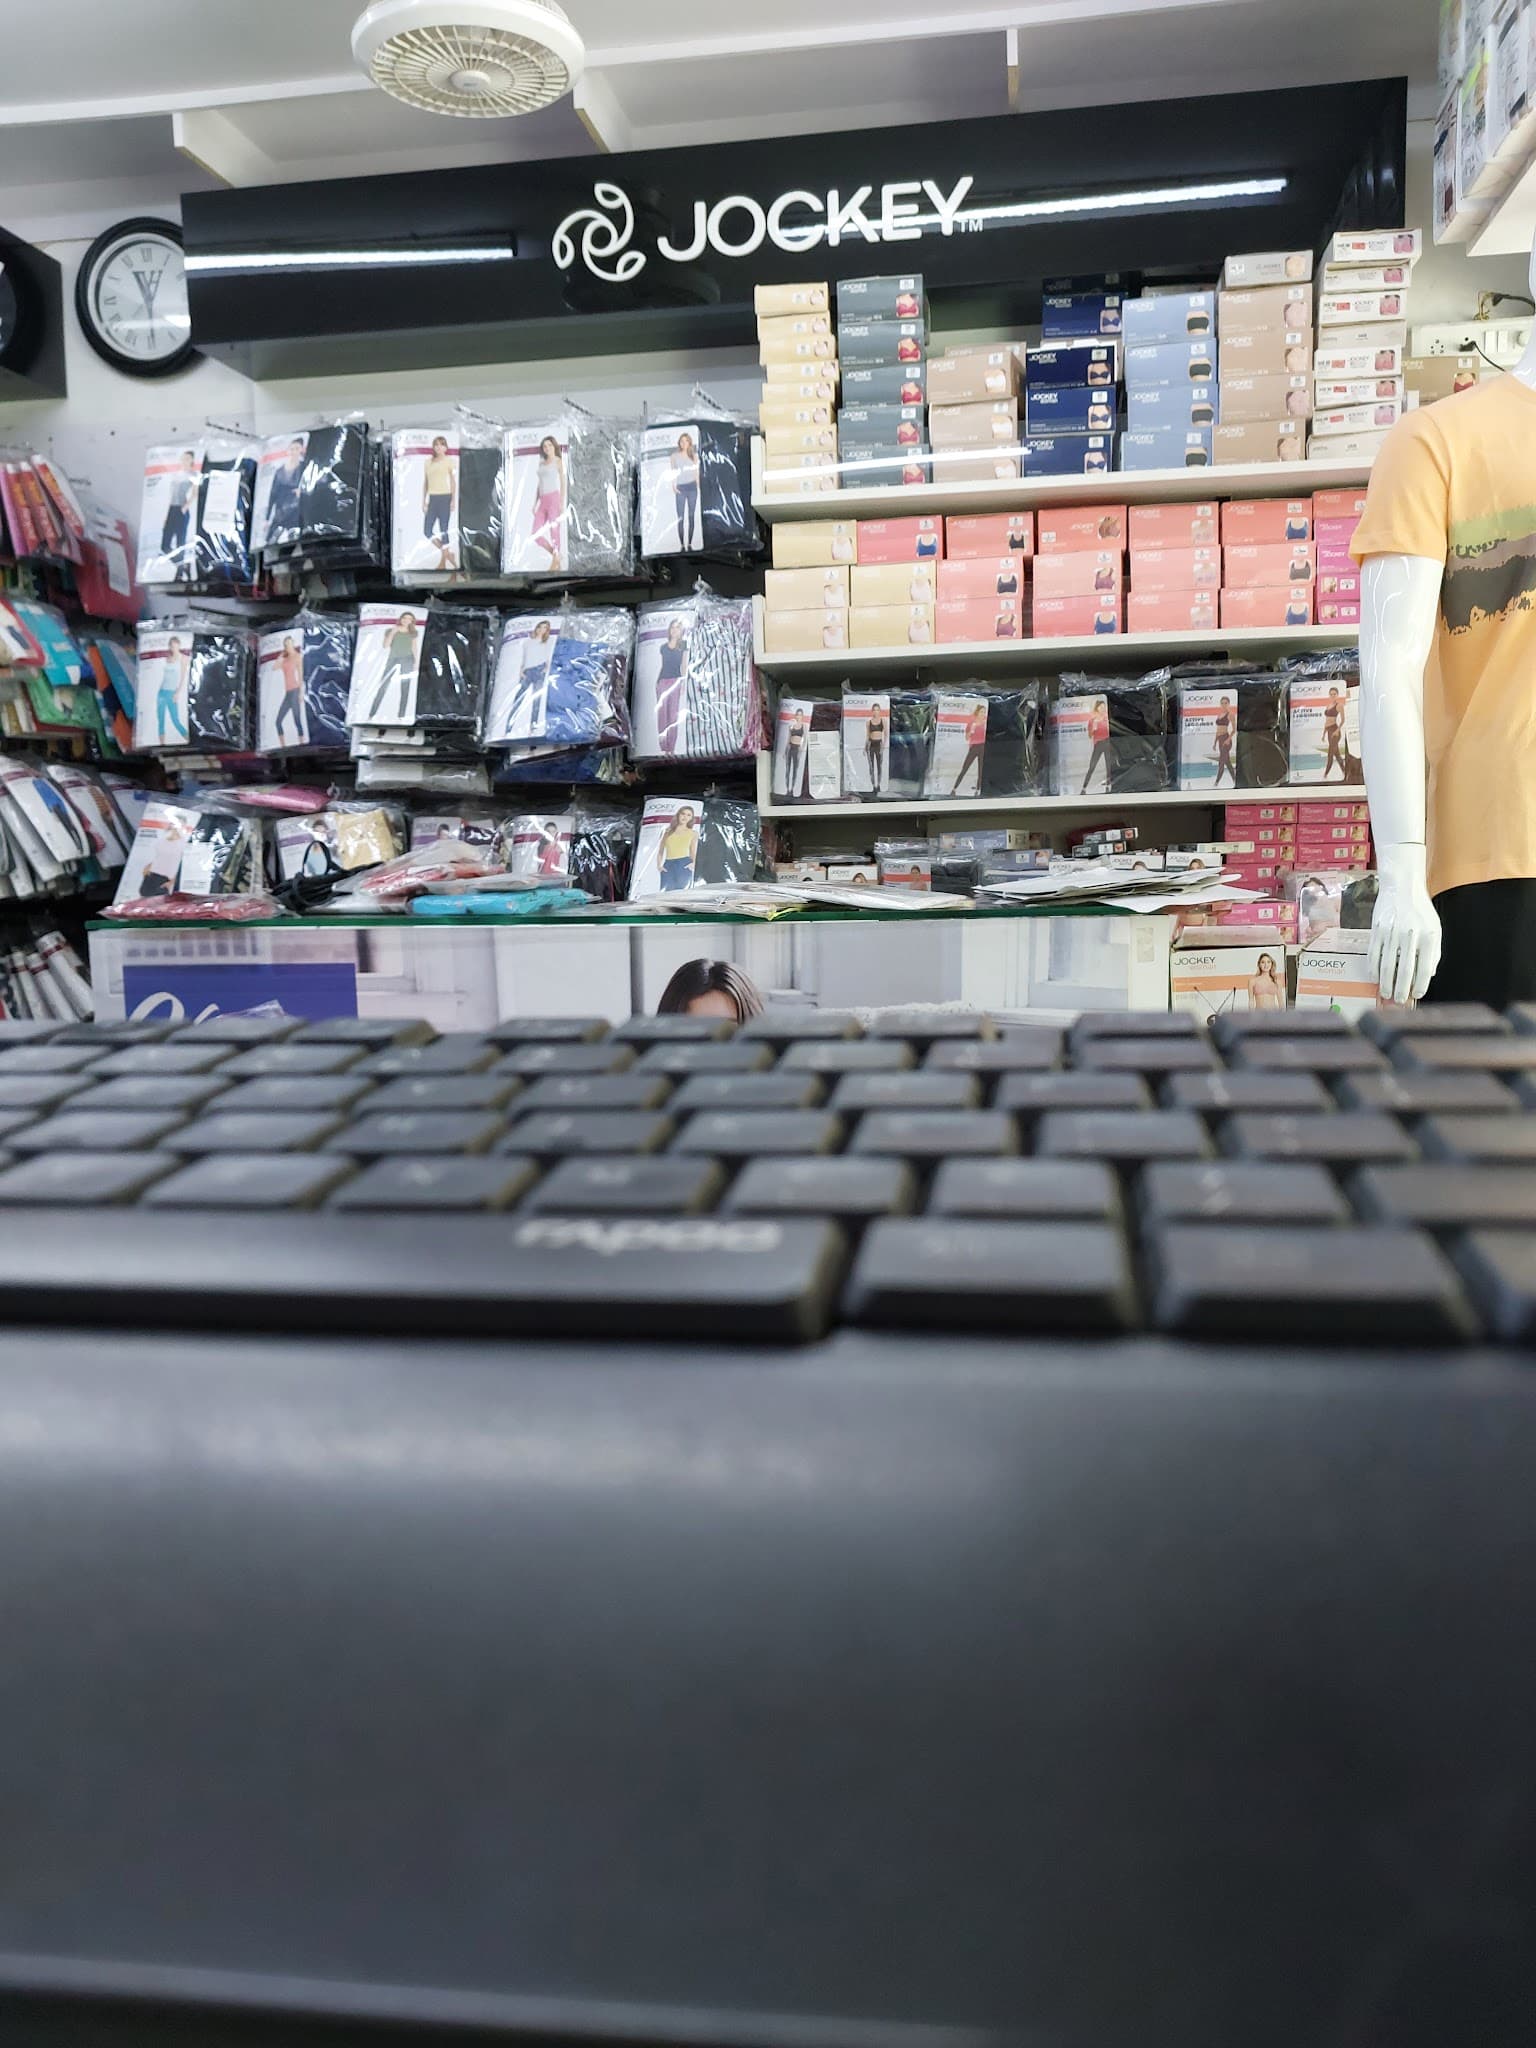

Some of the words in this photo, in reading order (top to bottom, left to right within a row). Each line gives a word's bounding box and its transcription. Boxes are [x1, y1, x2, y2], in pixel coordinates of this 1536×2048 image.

[657, 176, 974, 262] JOCKEY
[1174, 956, 1216, 966] JOCKEY
[1303, 959, 1346, 968] JOCKEY
